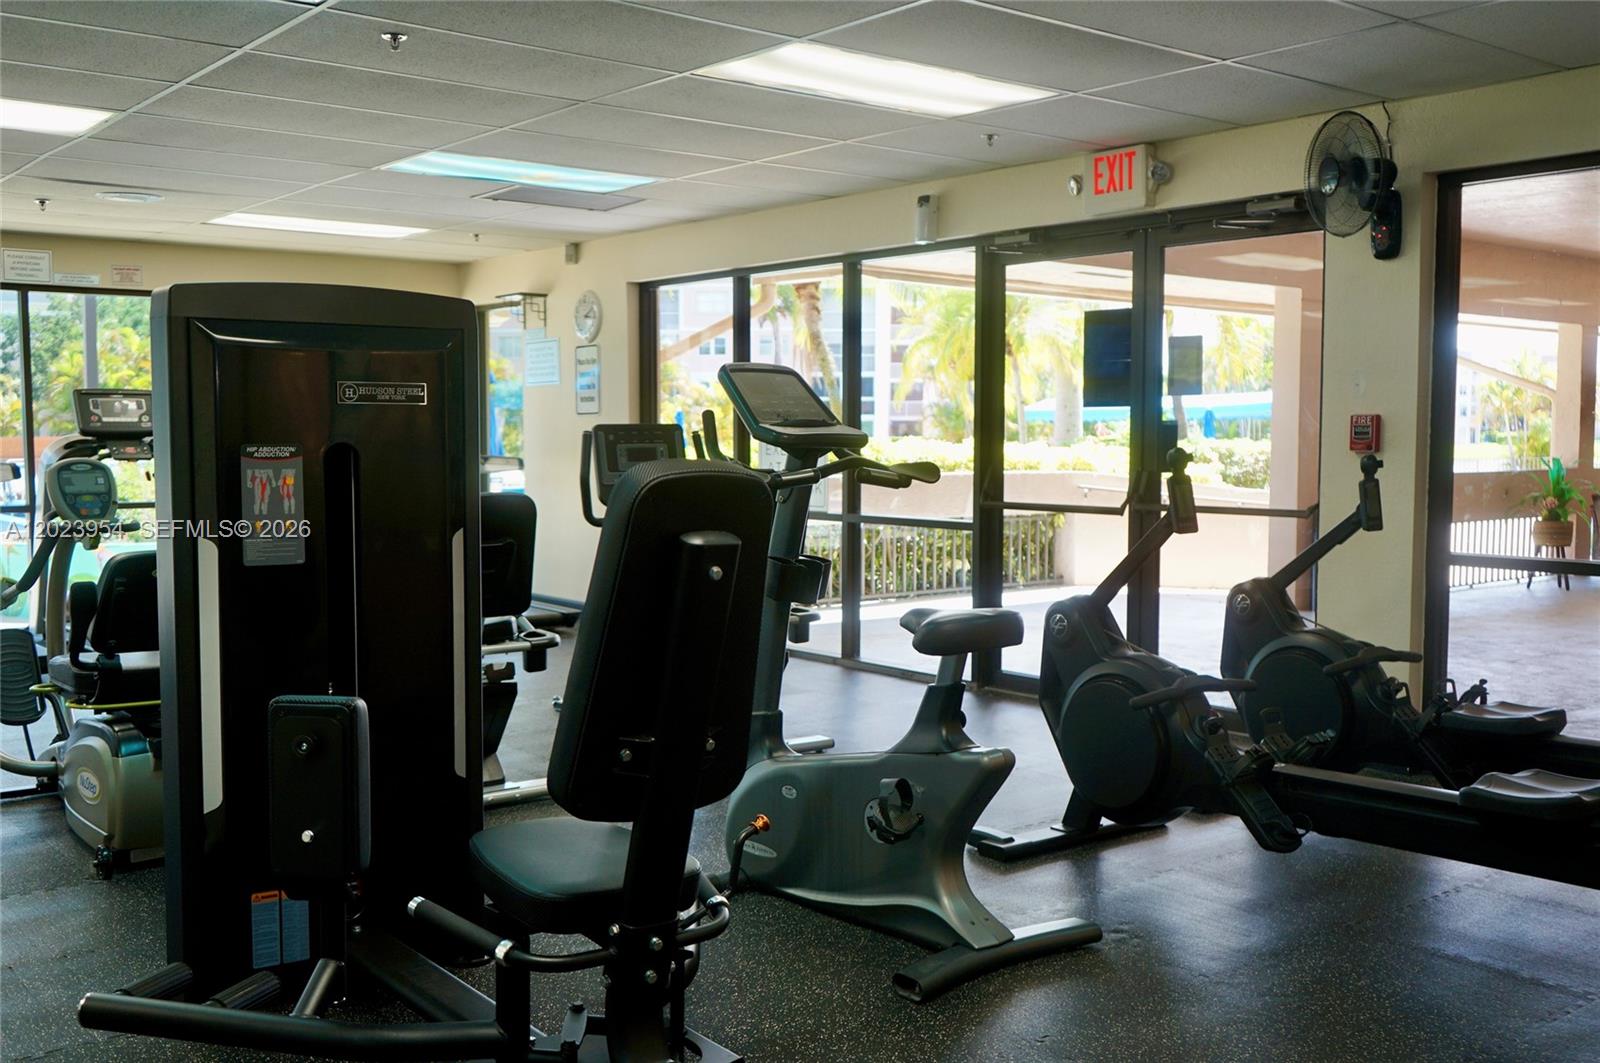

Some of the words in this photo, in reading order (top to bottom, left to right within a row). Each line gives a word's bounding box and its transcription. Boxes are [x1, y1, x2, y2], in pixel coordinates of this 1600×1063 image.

[1093, 150, 1137, 196] EXIT
[359, 387, 396, 395] HUDSON
[396, 388, 424, 396] STEEL
[1353, 415, 1372, 425] FIRE
